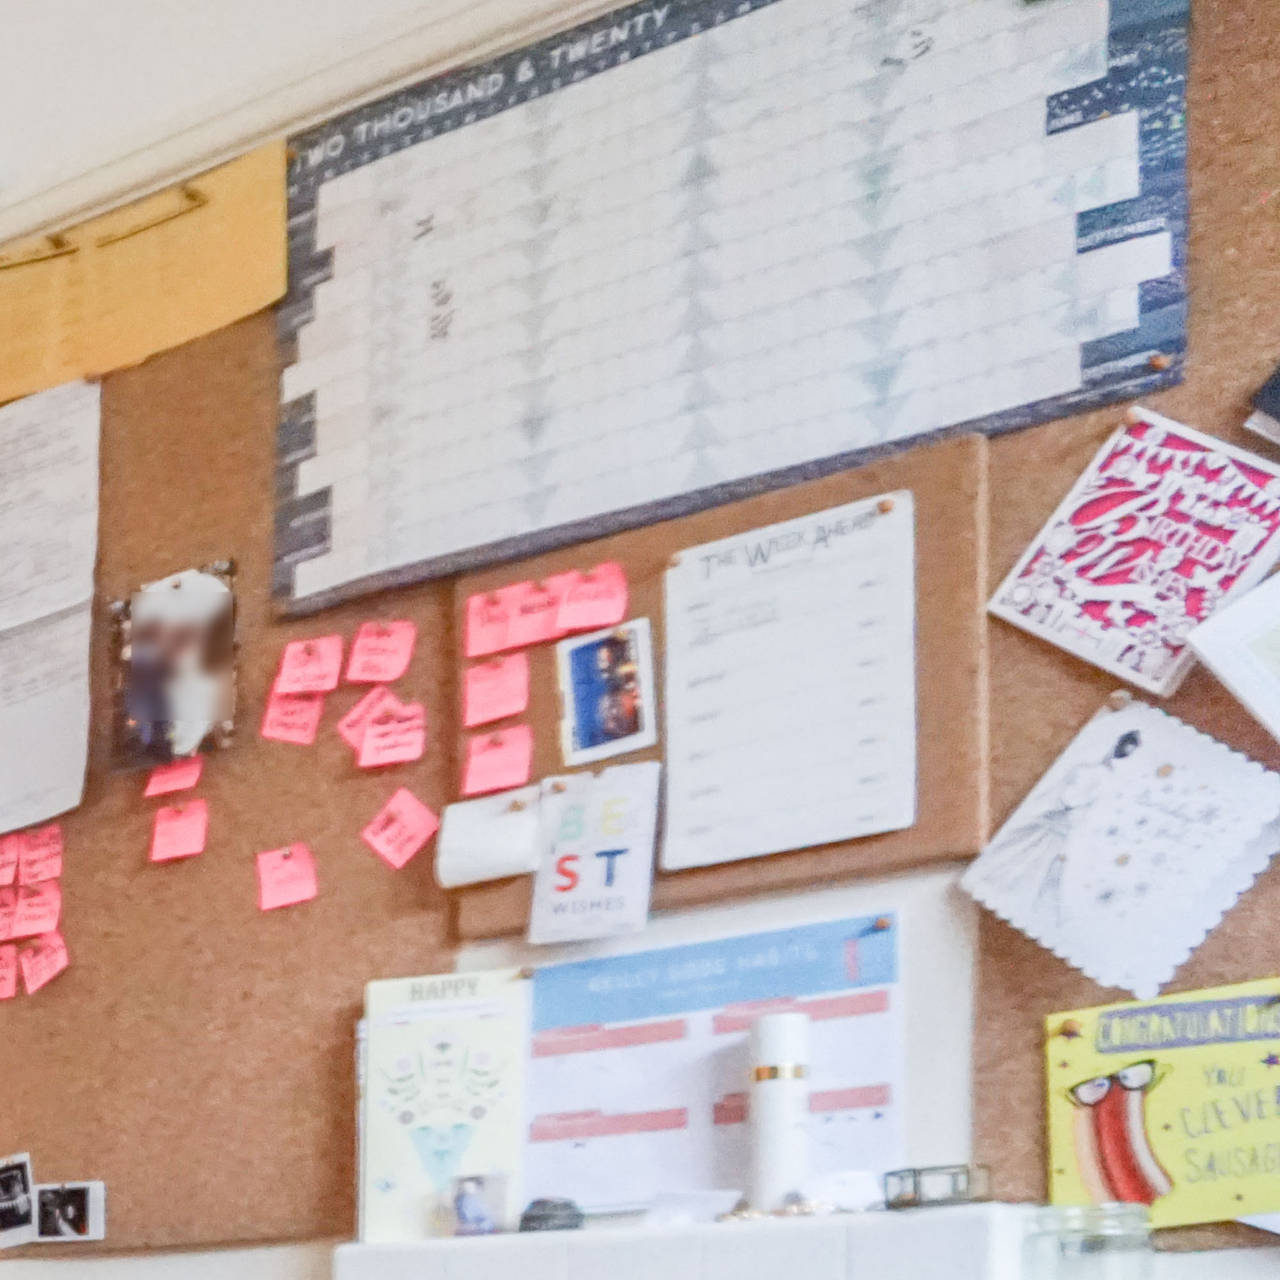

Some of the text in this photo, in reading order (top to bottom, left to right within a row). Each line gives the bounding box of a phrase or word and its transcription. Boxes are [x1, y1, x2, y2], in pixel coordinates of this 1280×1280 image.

[353, 73, 506, 144] THOUSAND
[515, 56, 538, 83] &
[550, 4, 671, 70] TWENTY
[552, 897, 626, 915] WISHES
[410, 976, 480, 1001] HAPPY
[1181, 1085, 1280, 1138] CLEVE
